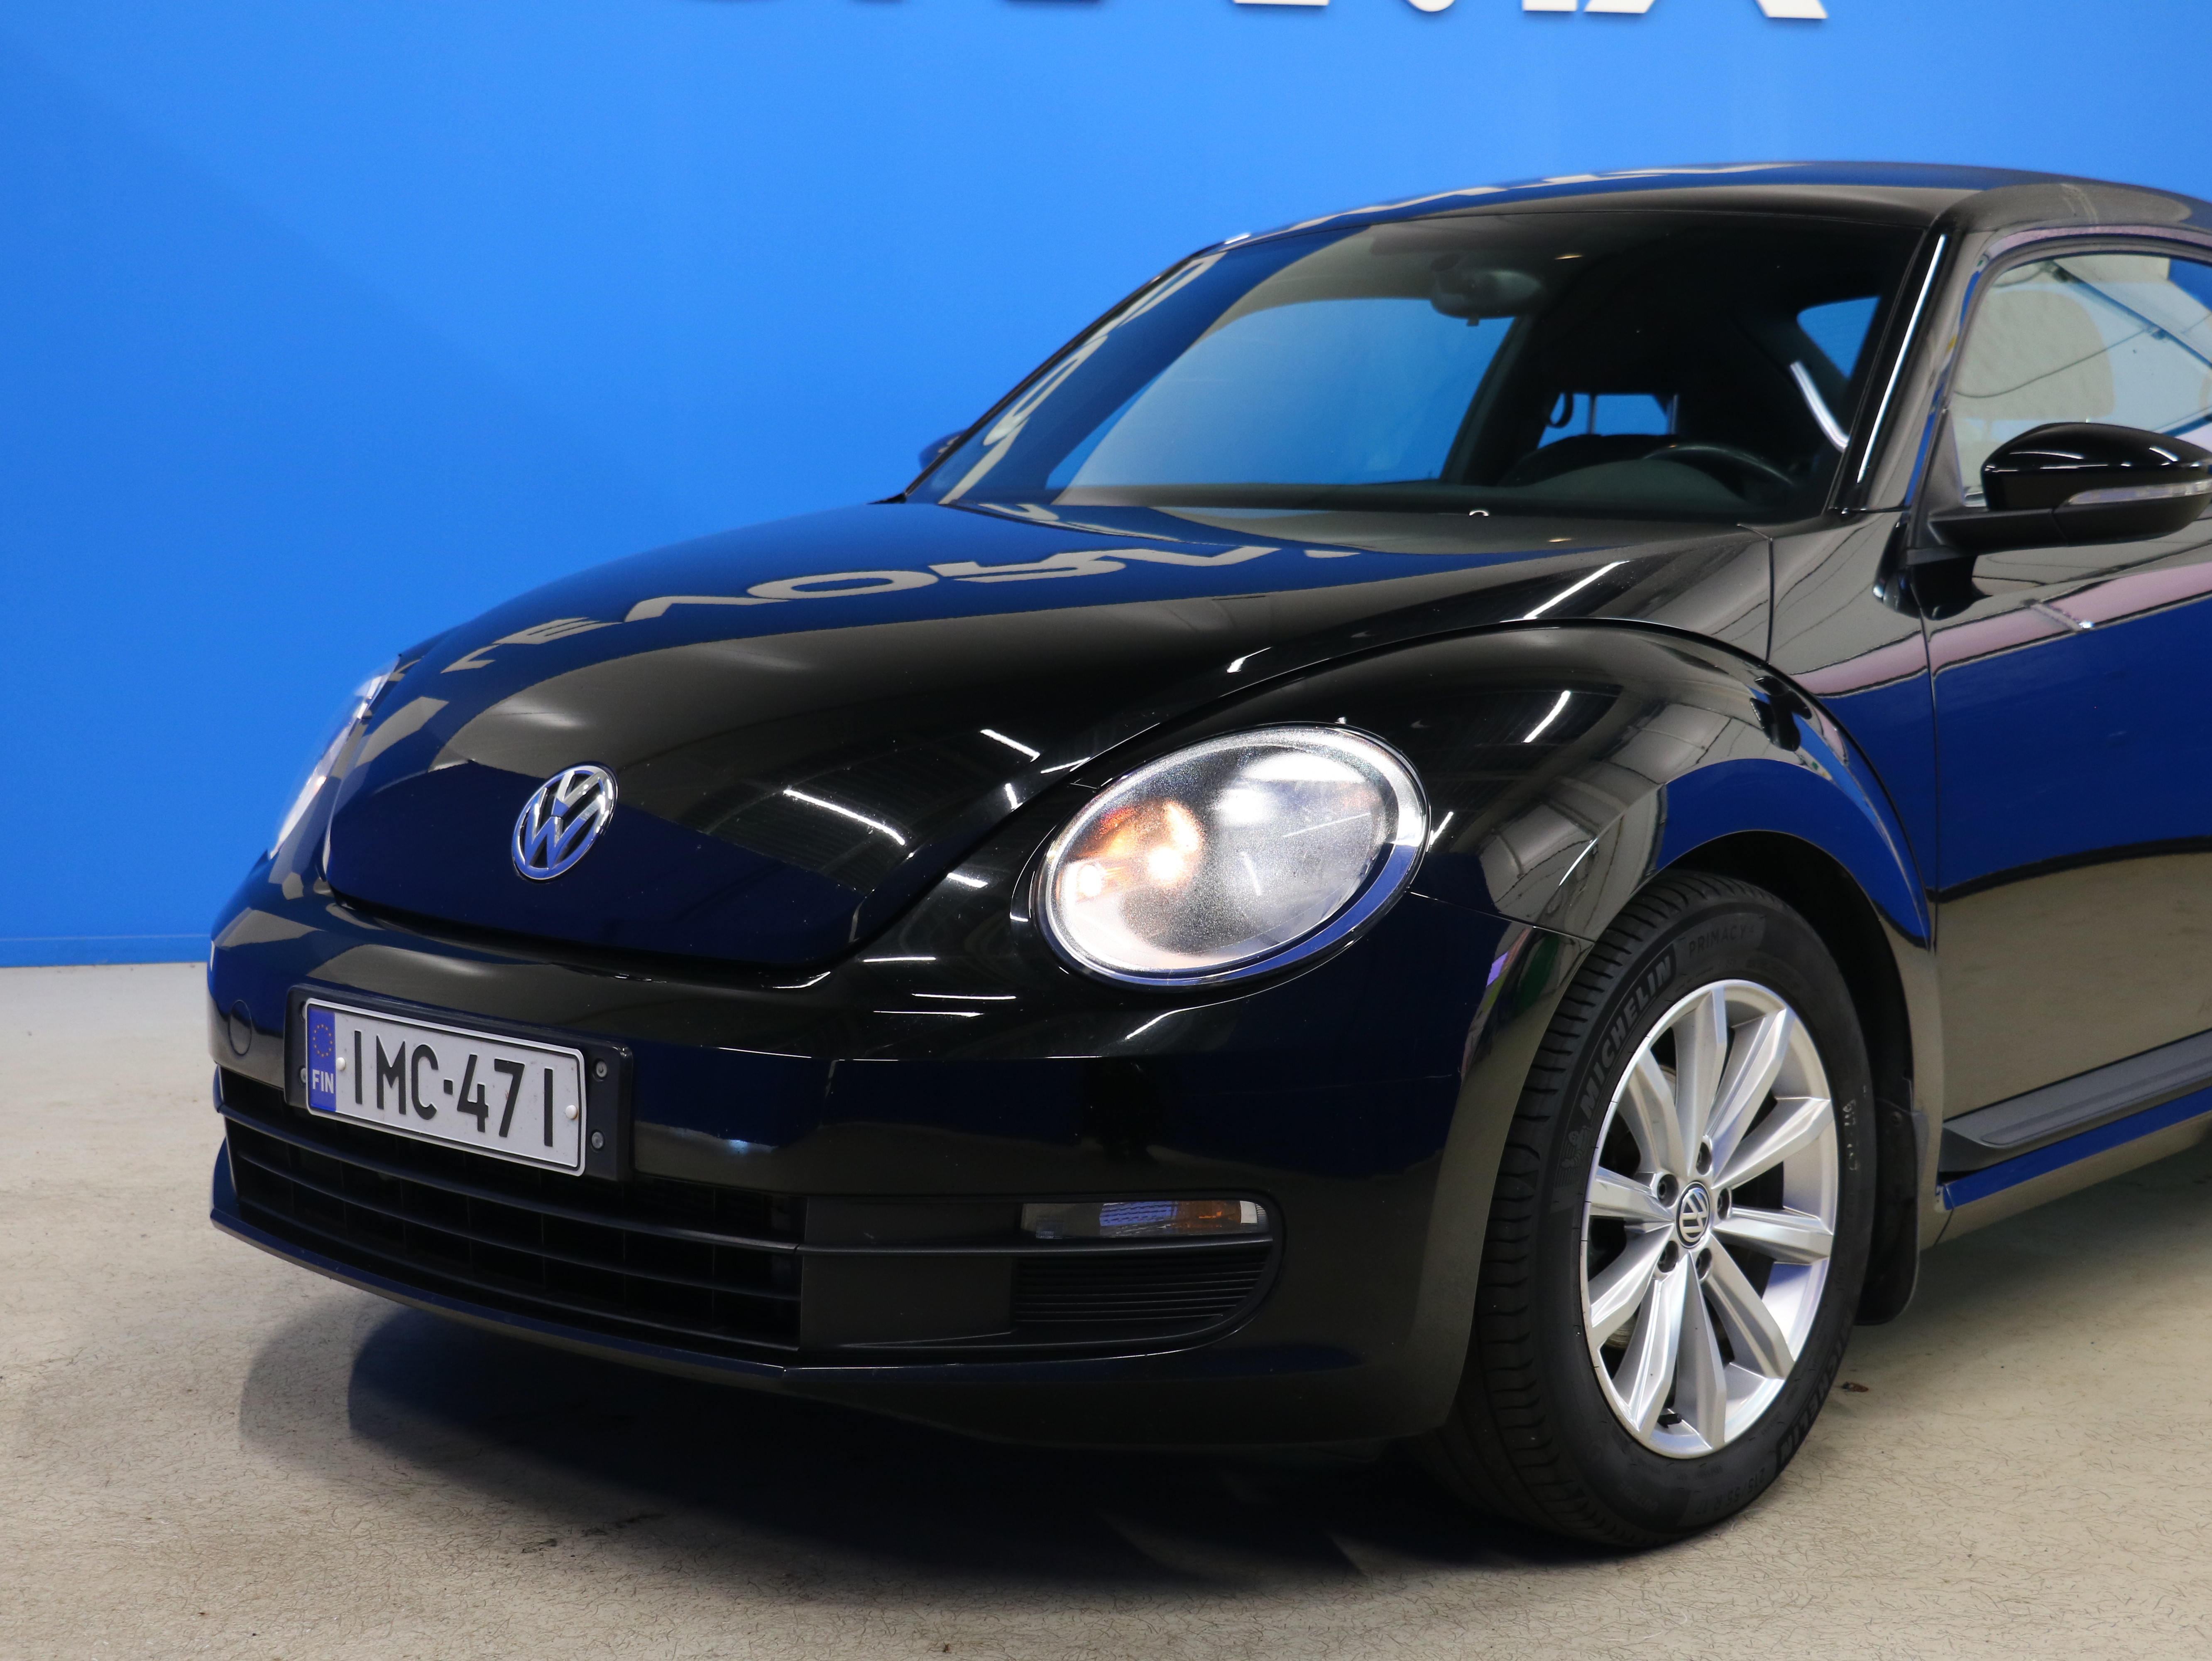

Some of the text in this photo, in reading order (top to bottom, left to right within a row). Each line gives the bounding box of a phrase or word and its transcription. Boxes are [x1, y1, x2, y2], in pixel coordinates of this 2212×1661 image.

[511, 764, 618, 880] VW
[1688, 924, 1747, 958] PRIMACY
[312, 1069, 334, 1094] FIN
[354, 1029, 553, 1147] IMC-471
[1580, 954, 1674, 1120] MICHELIN
